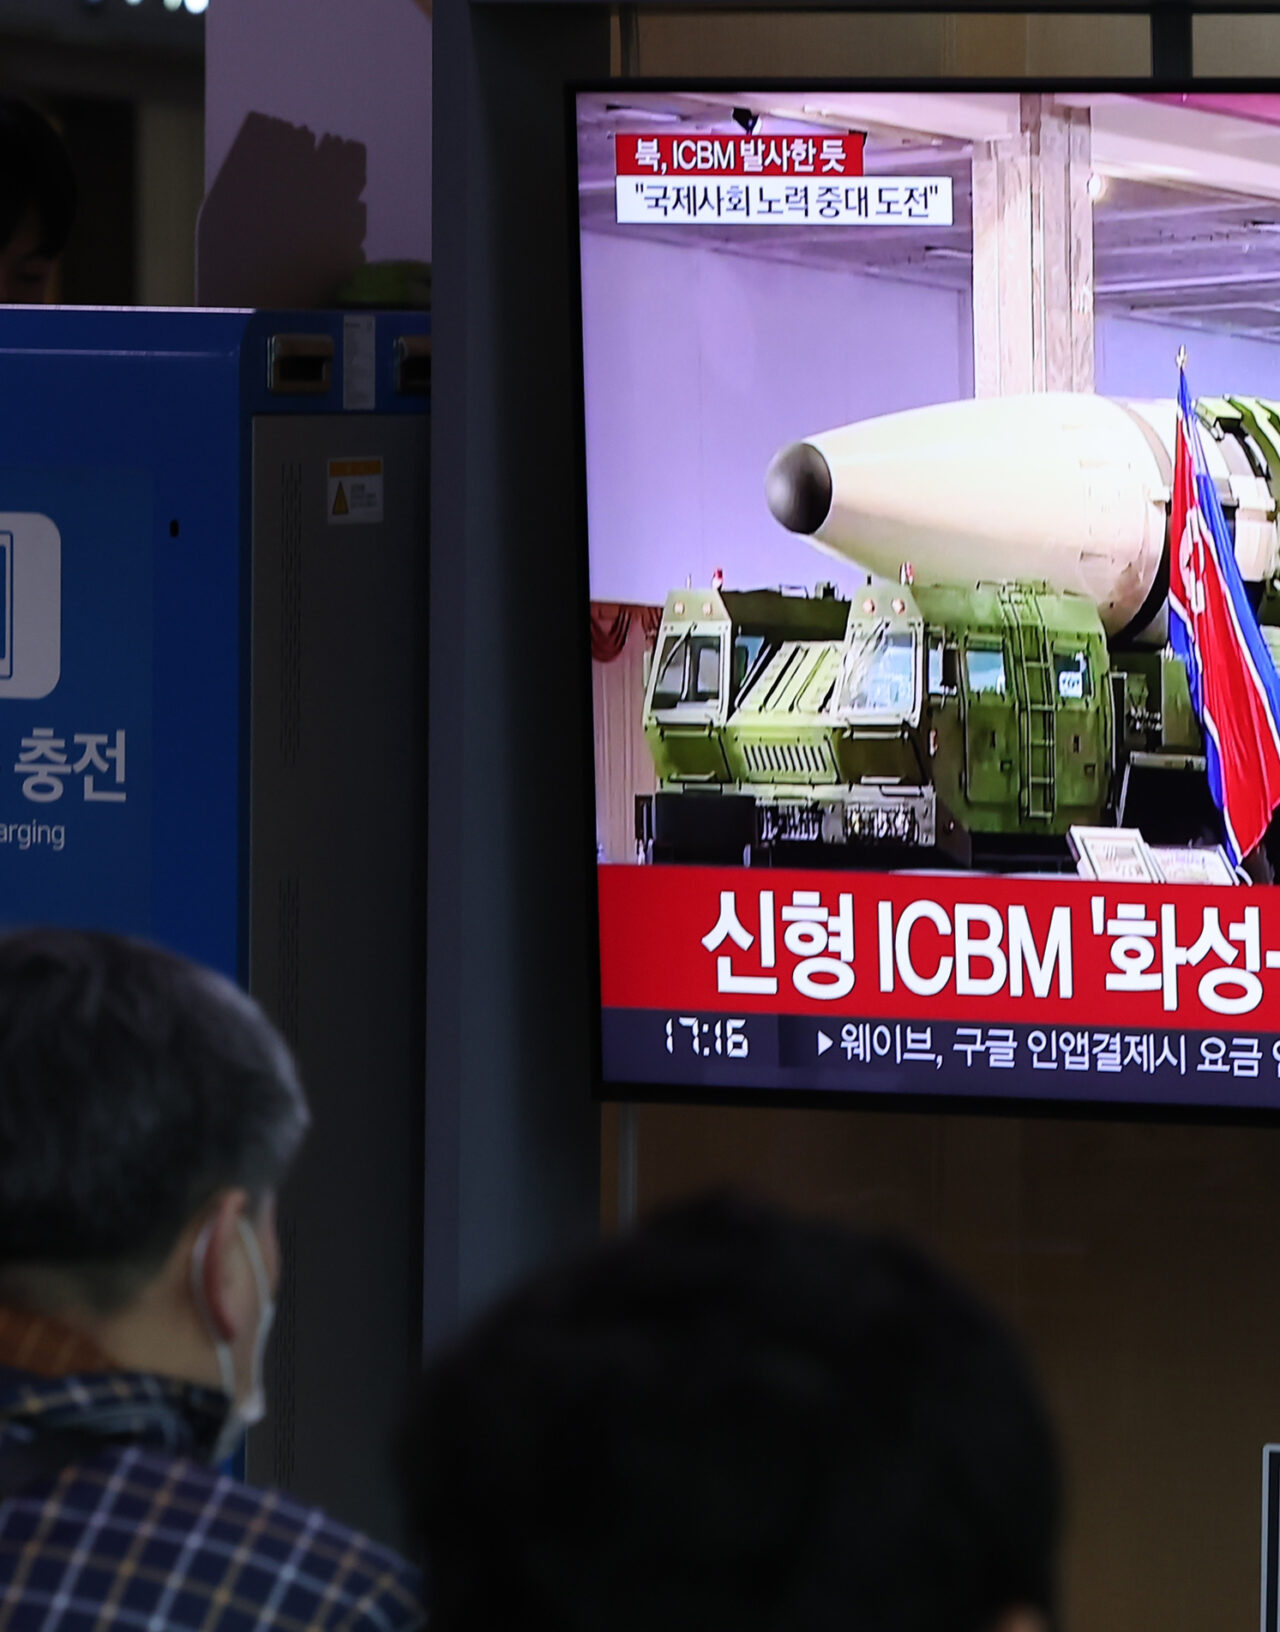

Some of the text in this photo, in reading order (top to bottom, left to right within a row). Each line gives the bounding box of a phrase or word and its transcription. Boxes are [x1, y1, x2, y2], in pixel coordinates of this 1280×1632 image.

[635, 138, 846, 174] 북, ICBM 발사한 듯
[635, 183, 938, 219] "국제사회 노력 중대 도전"
[14, 727, 127, 802] 충전
[700, 890, 857, 1000] 신형
[877, 899, 1074, 999] ICBM
[665, 1015, 749, 1058] 17:16
[840, 1022, 943, 1069] 웨이브,
[953, 1027, 1018, 1068] 구글
[1026, 1030, 1187, 1076] 인앱결제시
[1196, 1036, 1264, 1078] 요금
